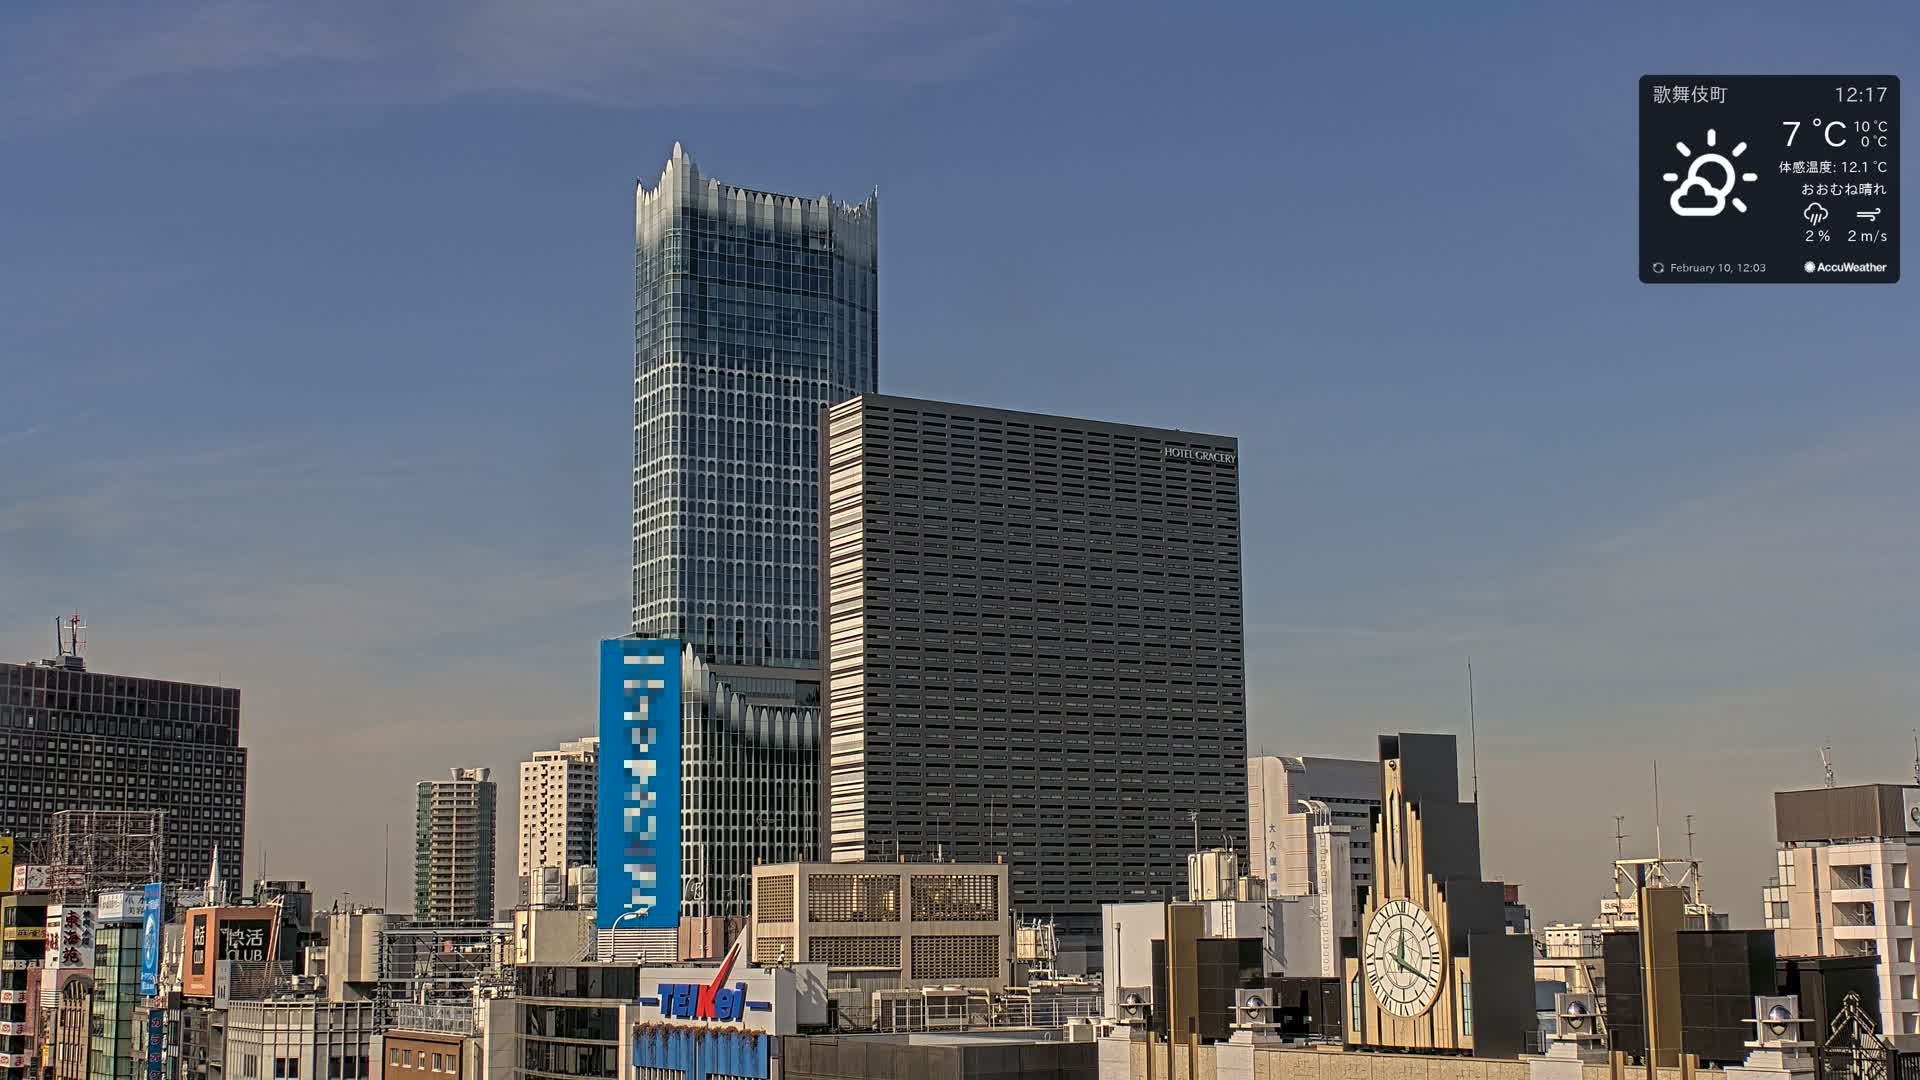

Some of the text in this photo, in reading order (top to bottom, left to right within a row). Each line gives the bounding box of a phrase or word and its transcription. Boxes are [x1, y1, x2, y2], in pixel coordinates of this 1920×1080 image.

[1164, 447, 1236, 464] HOTEL GRACERY
[62, 909, 81, 964] 東海苑
[228, 928, 264, 947] 快活
[228, 949, 263, 961] CLUB
